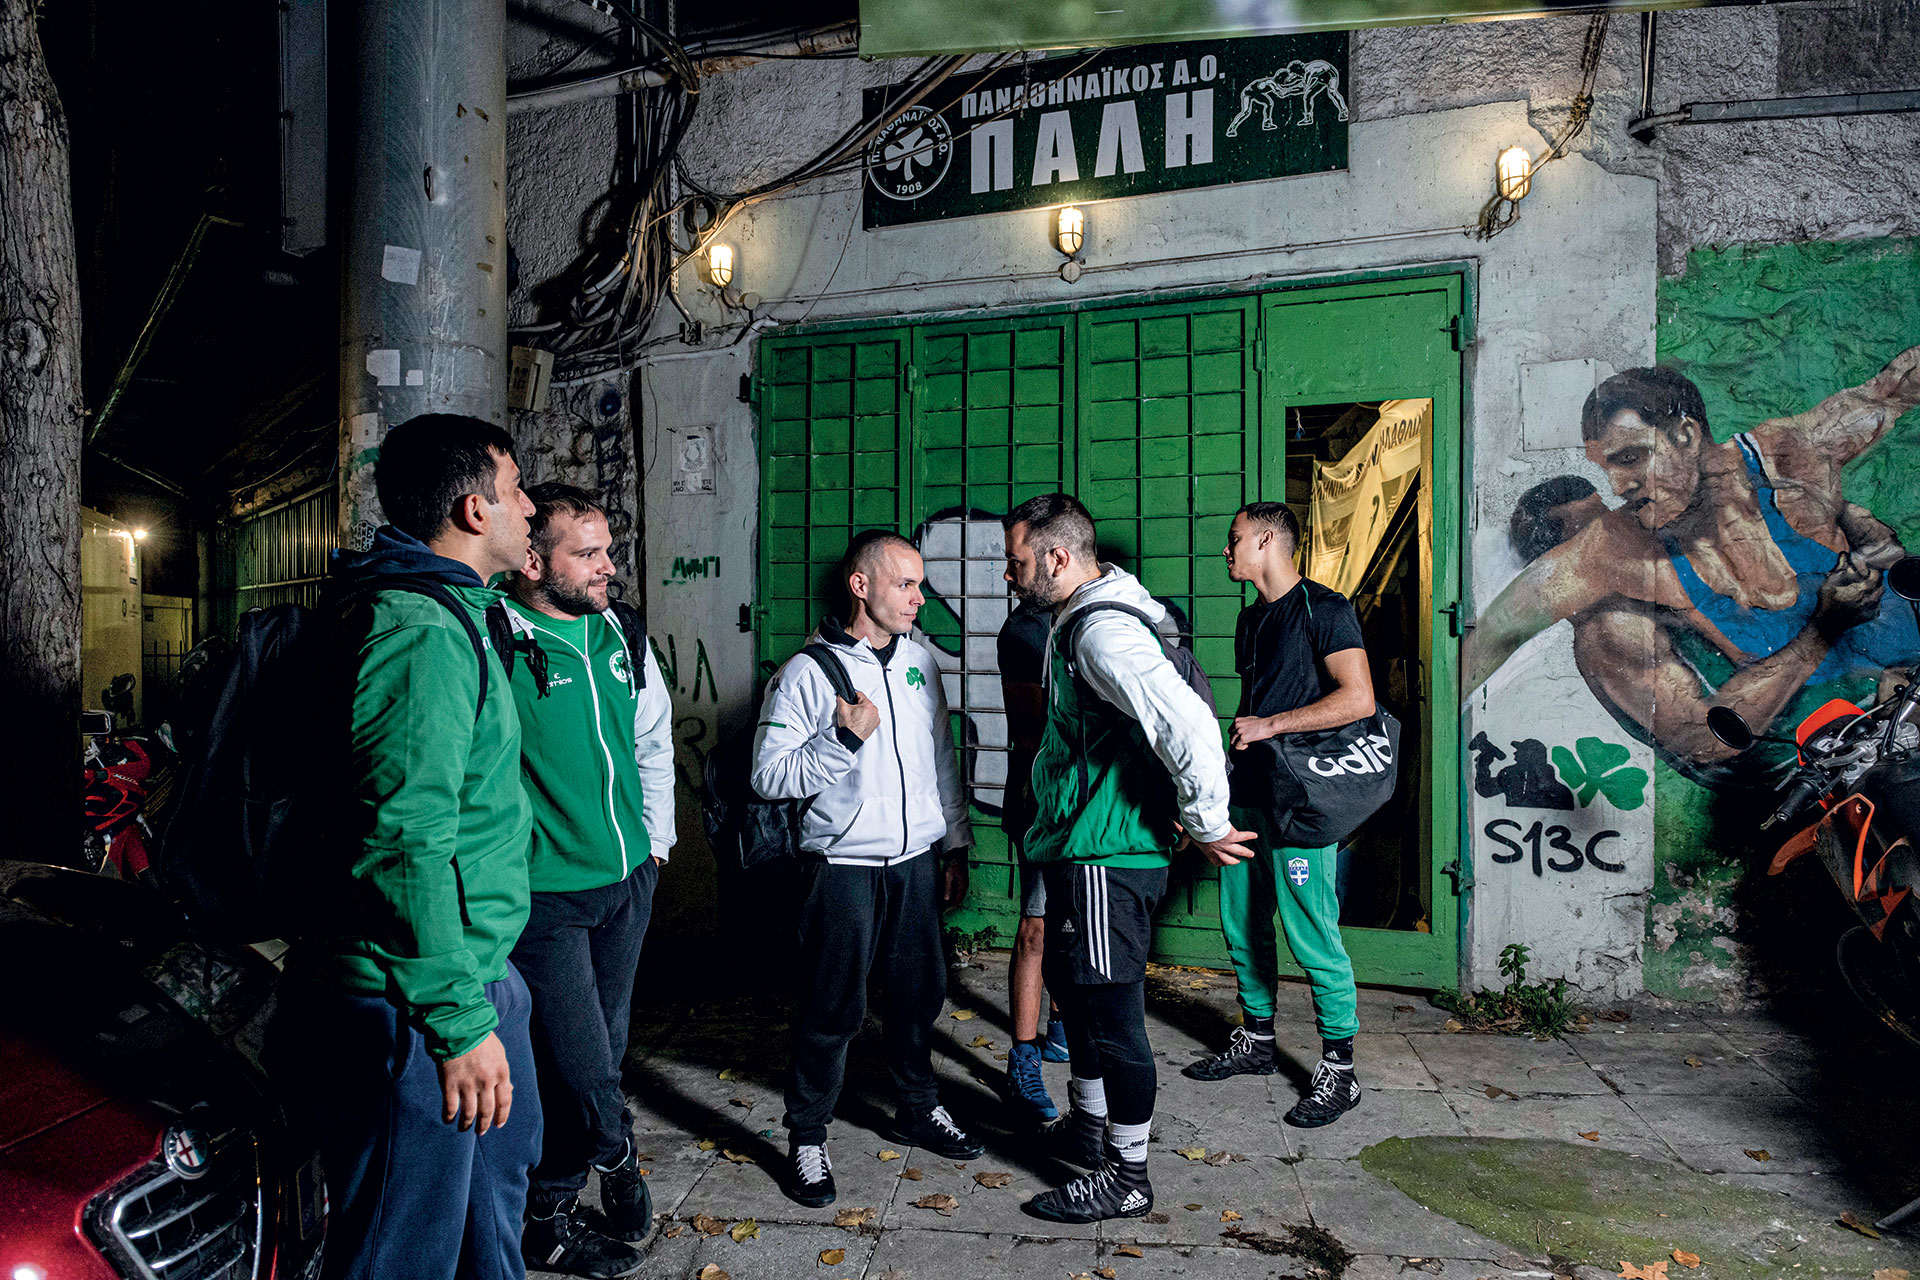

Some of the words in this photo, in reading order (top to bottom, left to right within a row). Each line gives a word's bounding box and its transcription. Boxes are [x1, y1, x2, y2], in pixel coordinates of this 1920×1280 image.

[961, 62, 1164, 119] ΠΑΝΑΘΗΝΑΪΚΟΣ
[1172, 54, 1226, 87] Α.Ο.
[970, 88, 1214, 195] ΠΑΛΗ
[896, 181, 923, 194] 1908
[1484, 818, 1626, 878] S13C
[1120, 1197, 1149, 1213] adidas
